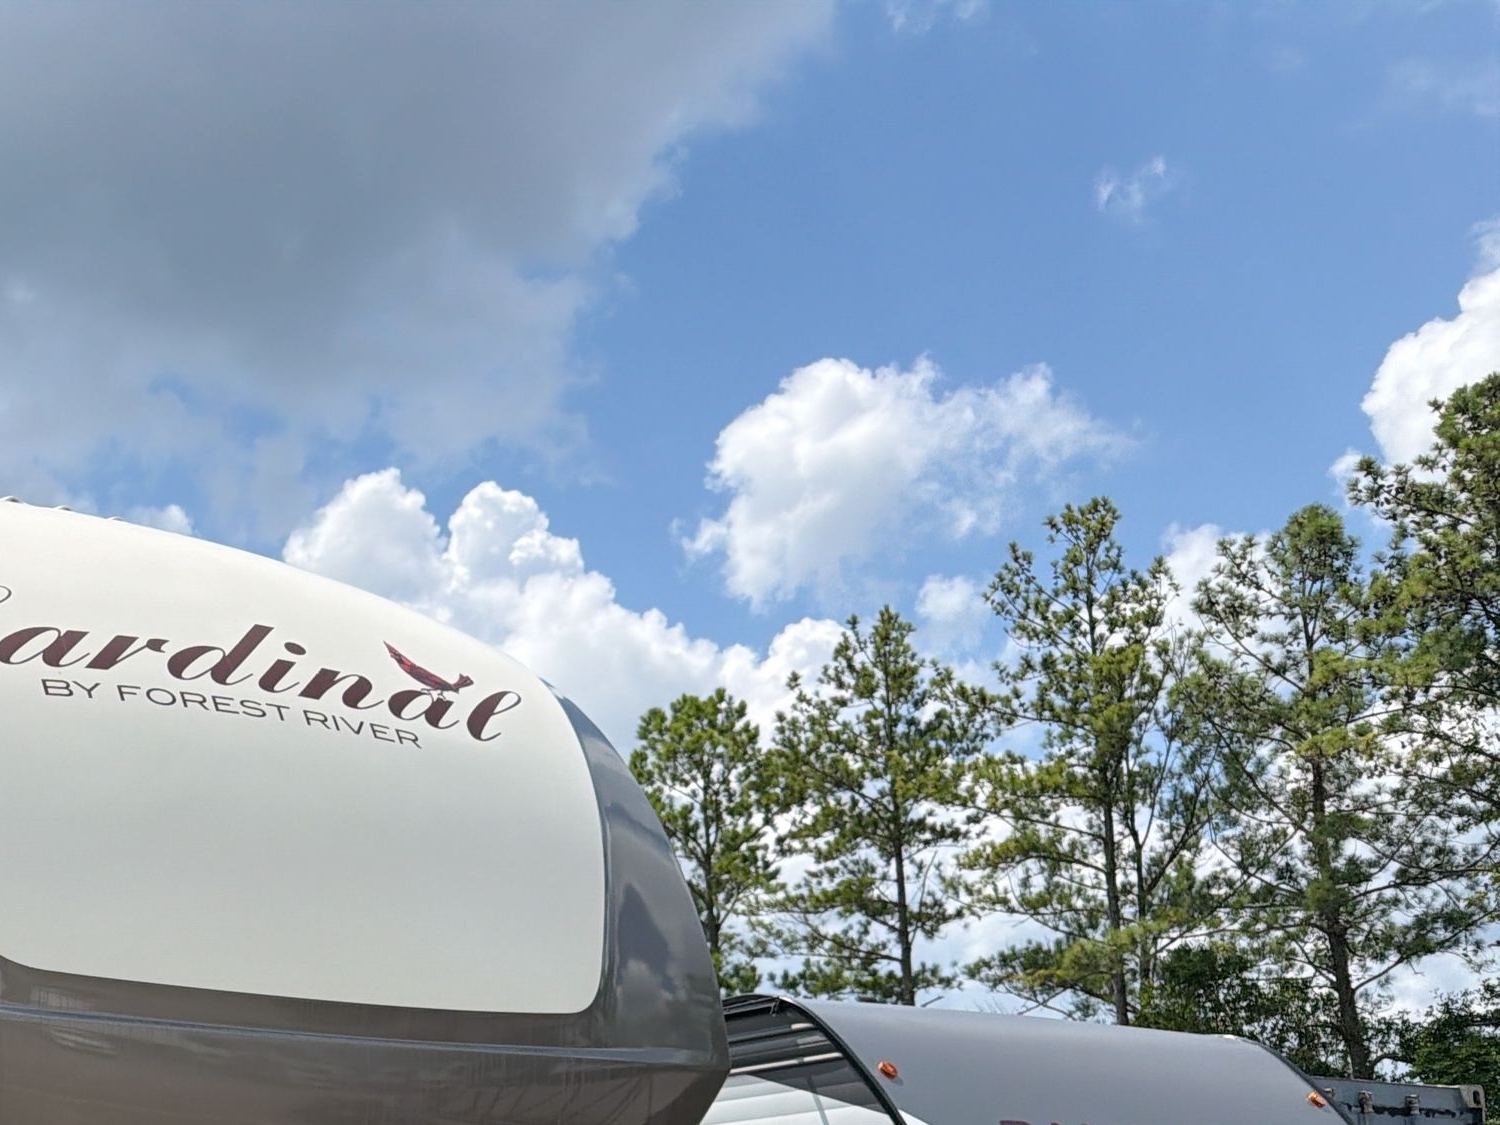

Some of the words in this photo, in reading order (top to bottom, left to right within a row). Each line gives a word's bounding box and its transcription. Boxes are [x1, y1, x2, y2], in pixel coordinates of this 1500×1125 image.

[40, 678, 103, 702] BY
[116, 684, 292, 723] FOREST
[302, 708, 423, 750] RIVER
